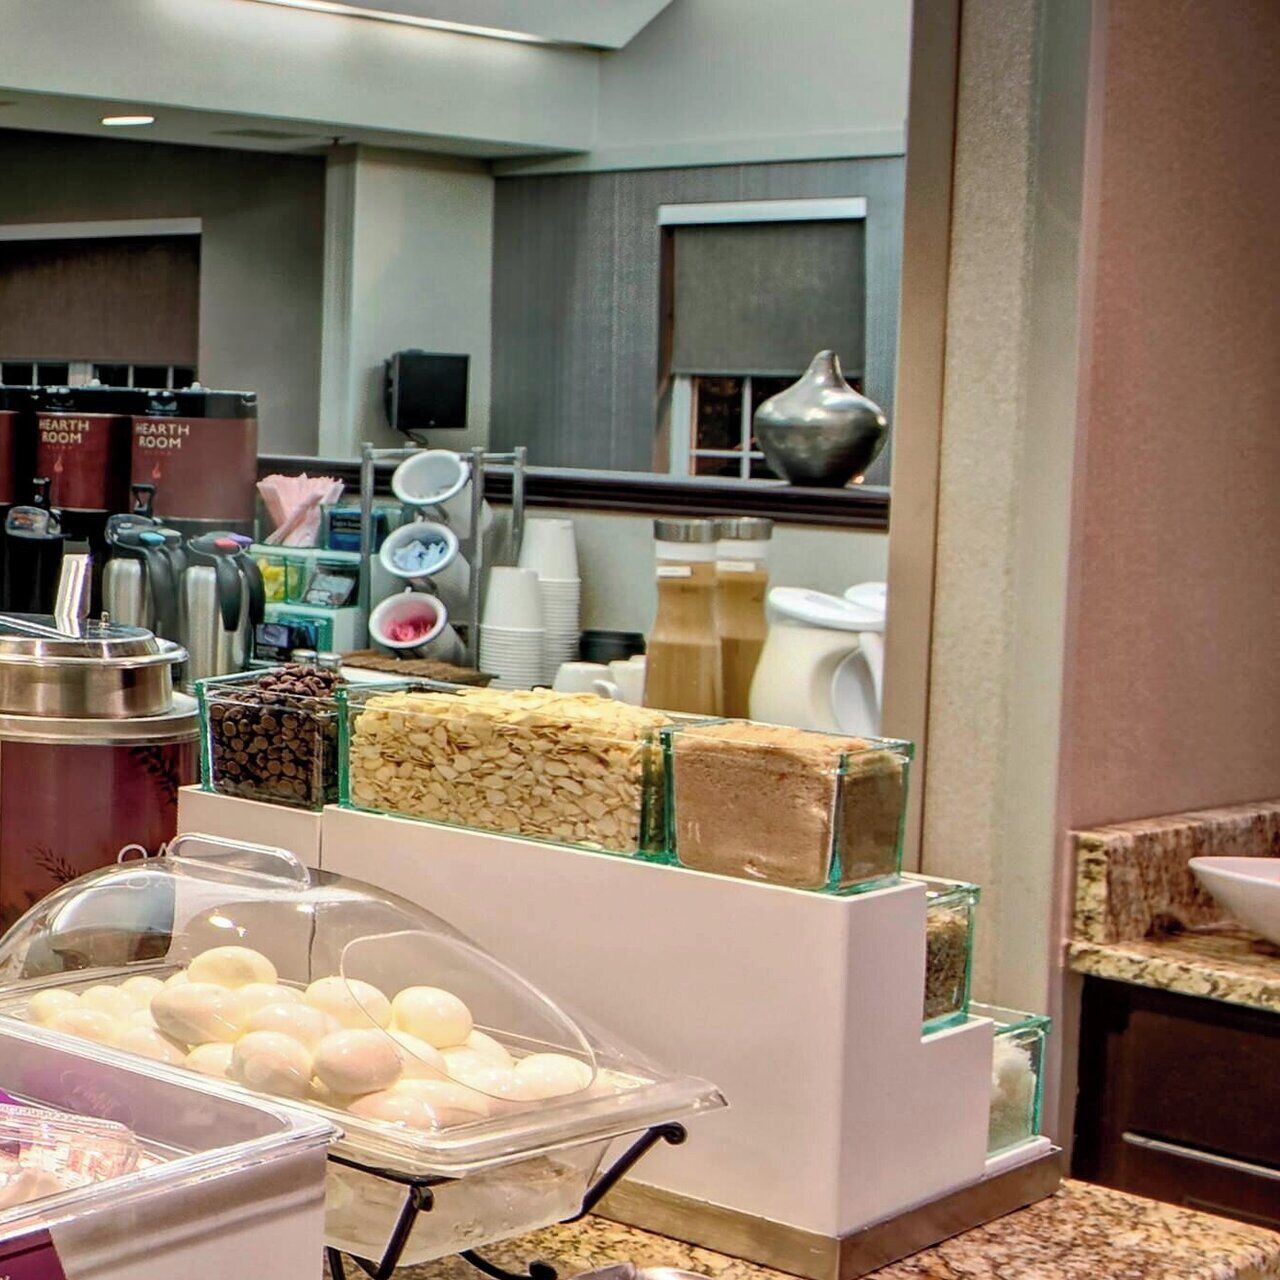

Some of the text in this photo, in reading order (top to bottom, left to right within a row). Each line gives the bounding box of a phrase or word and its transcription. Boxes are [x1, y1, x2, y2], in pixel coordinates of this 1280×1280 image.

[39, 419, 90, 431] HEARTH
[135, 423, 190, 436] HEARTH
[42, 431, 82, 444] ROOM
[139, 436, 182, 449] ROOM
